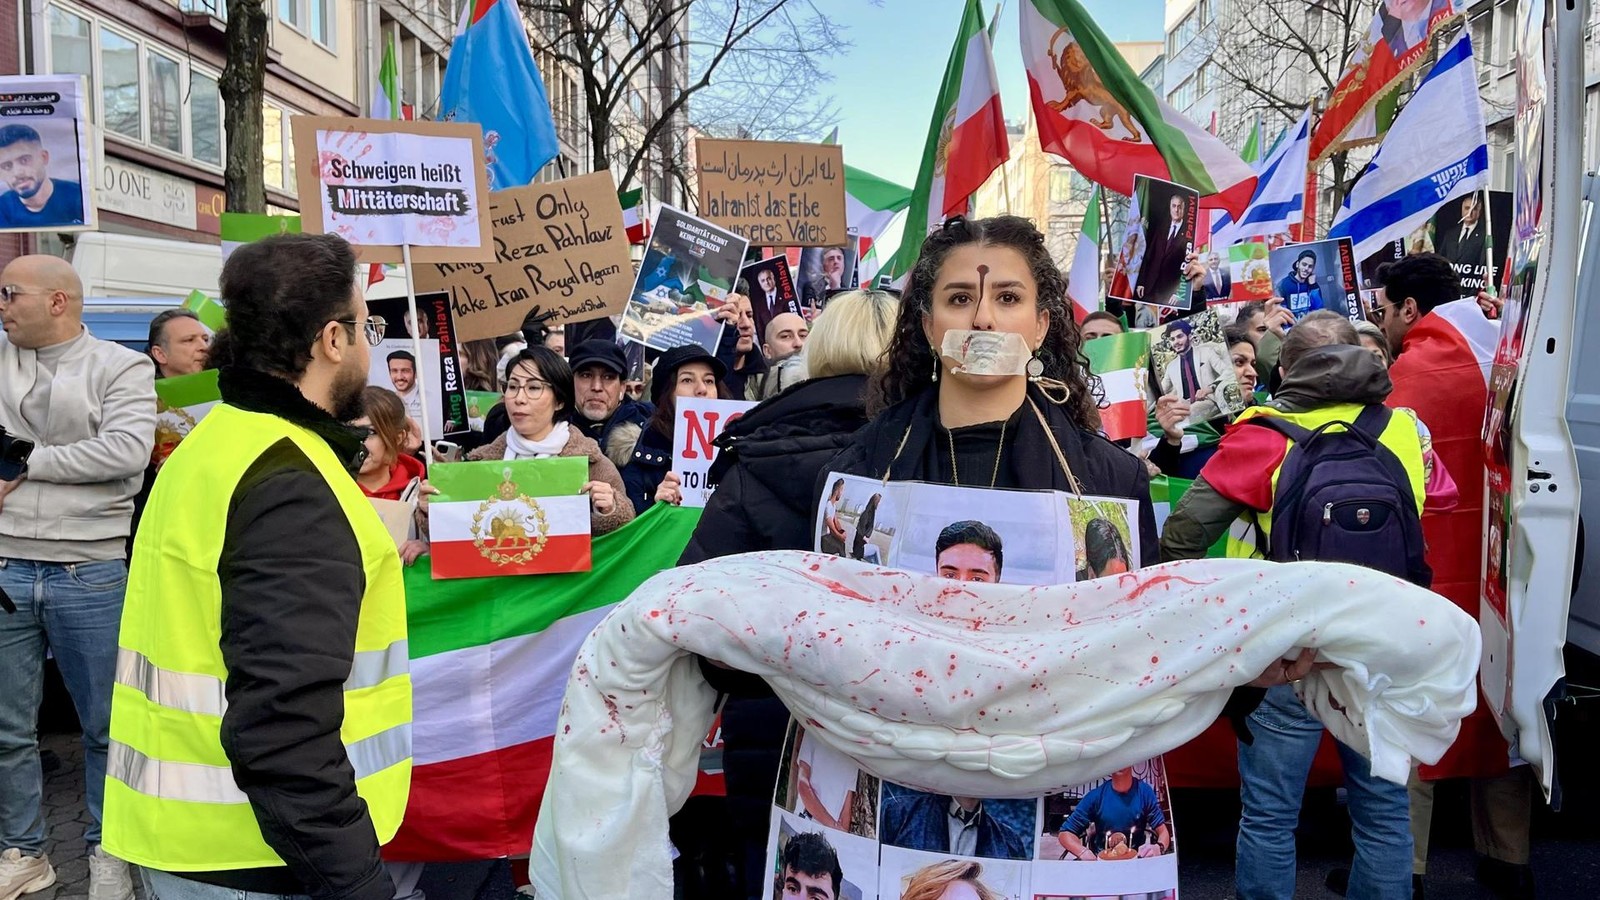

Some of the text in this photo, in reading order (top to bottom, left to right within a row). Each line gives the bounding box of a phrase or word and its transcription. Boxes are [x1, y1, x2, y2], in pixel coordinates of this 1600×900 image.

[331, 159, 462, 183] Schweigen heißt
[701, 150, 727, 173] است
[767, 153, 787, 185] ارث
[790, 154, 818, 187] ایران
[820, 157, 836, 186] بله
[119, 170, 151, 200] ONE
[337, 188, 460, 212] Mittäterschaft
[536, 188, 590, 220] Only
[764, 190, 787, 217] das
[789, 192, 820, 218] Erbe
[1186, 194, 1197, 239] Pahlavi
[493, 236, 549, 263] Reza
[544, 219, 613, 251] Pahlavi
[676, 219, 728, 247] SOLIDARITÄT KENNT
[679, 230, 696, 243] KEINE
[696, 237, 721, 253] GRENZEN
[786, 219, 827, 243] Vaters
[484, 274, 530, 308] Iran
[523, 258, 581, 297] Royal
[580, 261, 620, 286] Again
[775, 261, 798, 316] za Pahlavi
[1339, 244, 1359, 322] Reza Pahlavi
[432, 299, 463, 426] King Reza Pahlavi
[682, 410, 745, 460] N
[683, 471, 699, 488] TO
